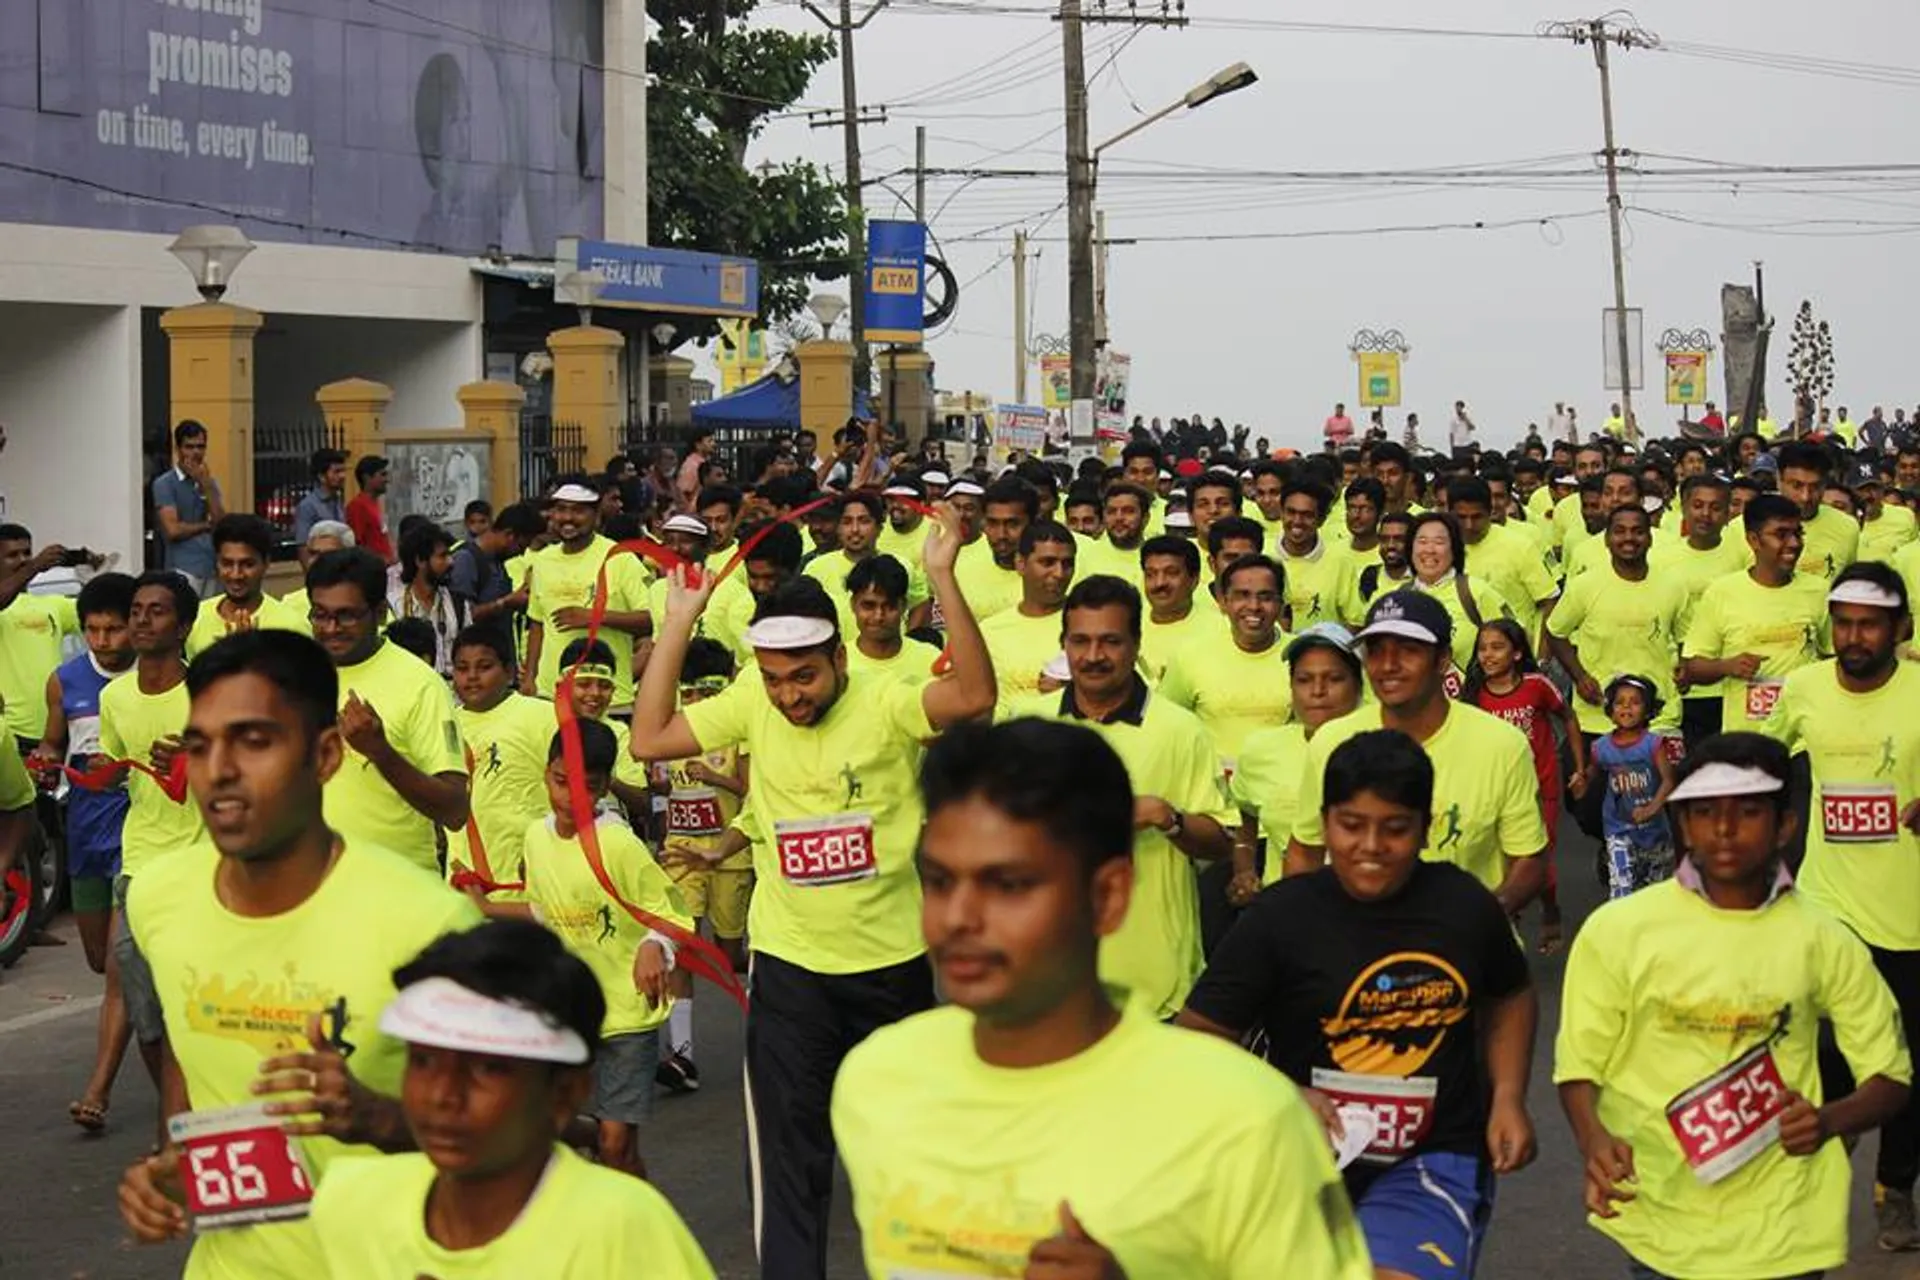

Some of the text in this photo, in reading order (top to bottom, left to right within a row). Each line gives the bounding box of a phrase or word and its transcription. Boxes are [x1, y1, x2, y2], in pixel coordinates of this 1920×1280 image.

[148, 29, 292, 96] promises
[97, 103, 315, 170] on time, every time.
[634, 263, 664, 289] BANK
[877, 272, 914, 288] ATM
[670, 803, 716, 827] 6367
[1824, 800, 1891, 832] 6058
[783, 833, 867, 873] 6588
[1679, 1061, 1780, 1155] 5525
